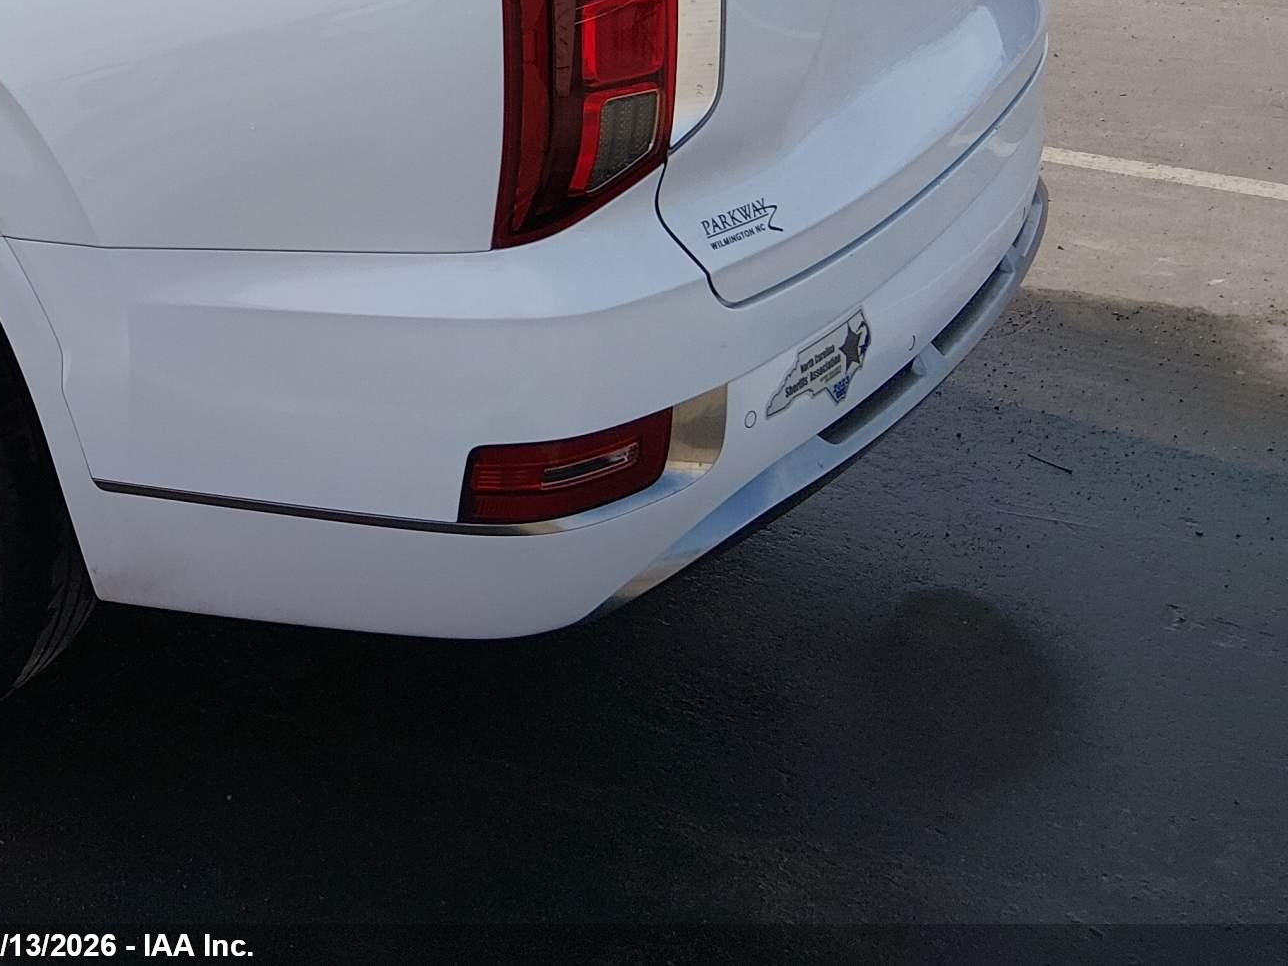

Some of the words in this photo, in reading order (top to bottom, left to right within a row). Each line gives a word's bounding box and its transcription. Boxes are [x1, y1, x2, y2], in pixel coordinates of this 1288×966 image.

[701, 197, 768, 235] PARKWAY
[710, 228, 755, 250] WILMINGTON
[755, 223, 766, 234] NC
